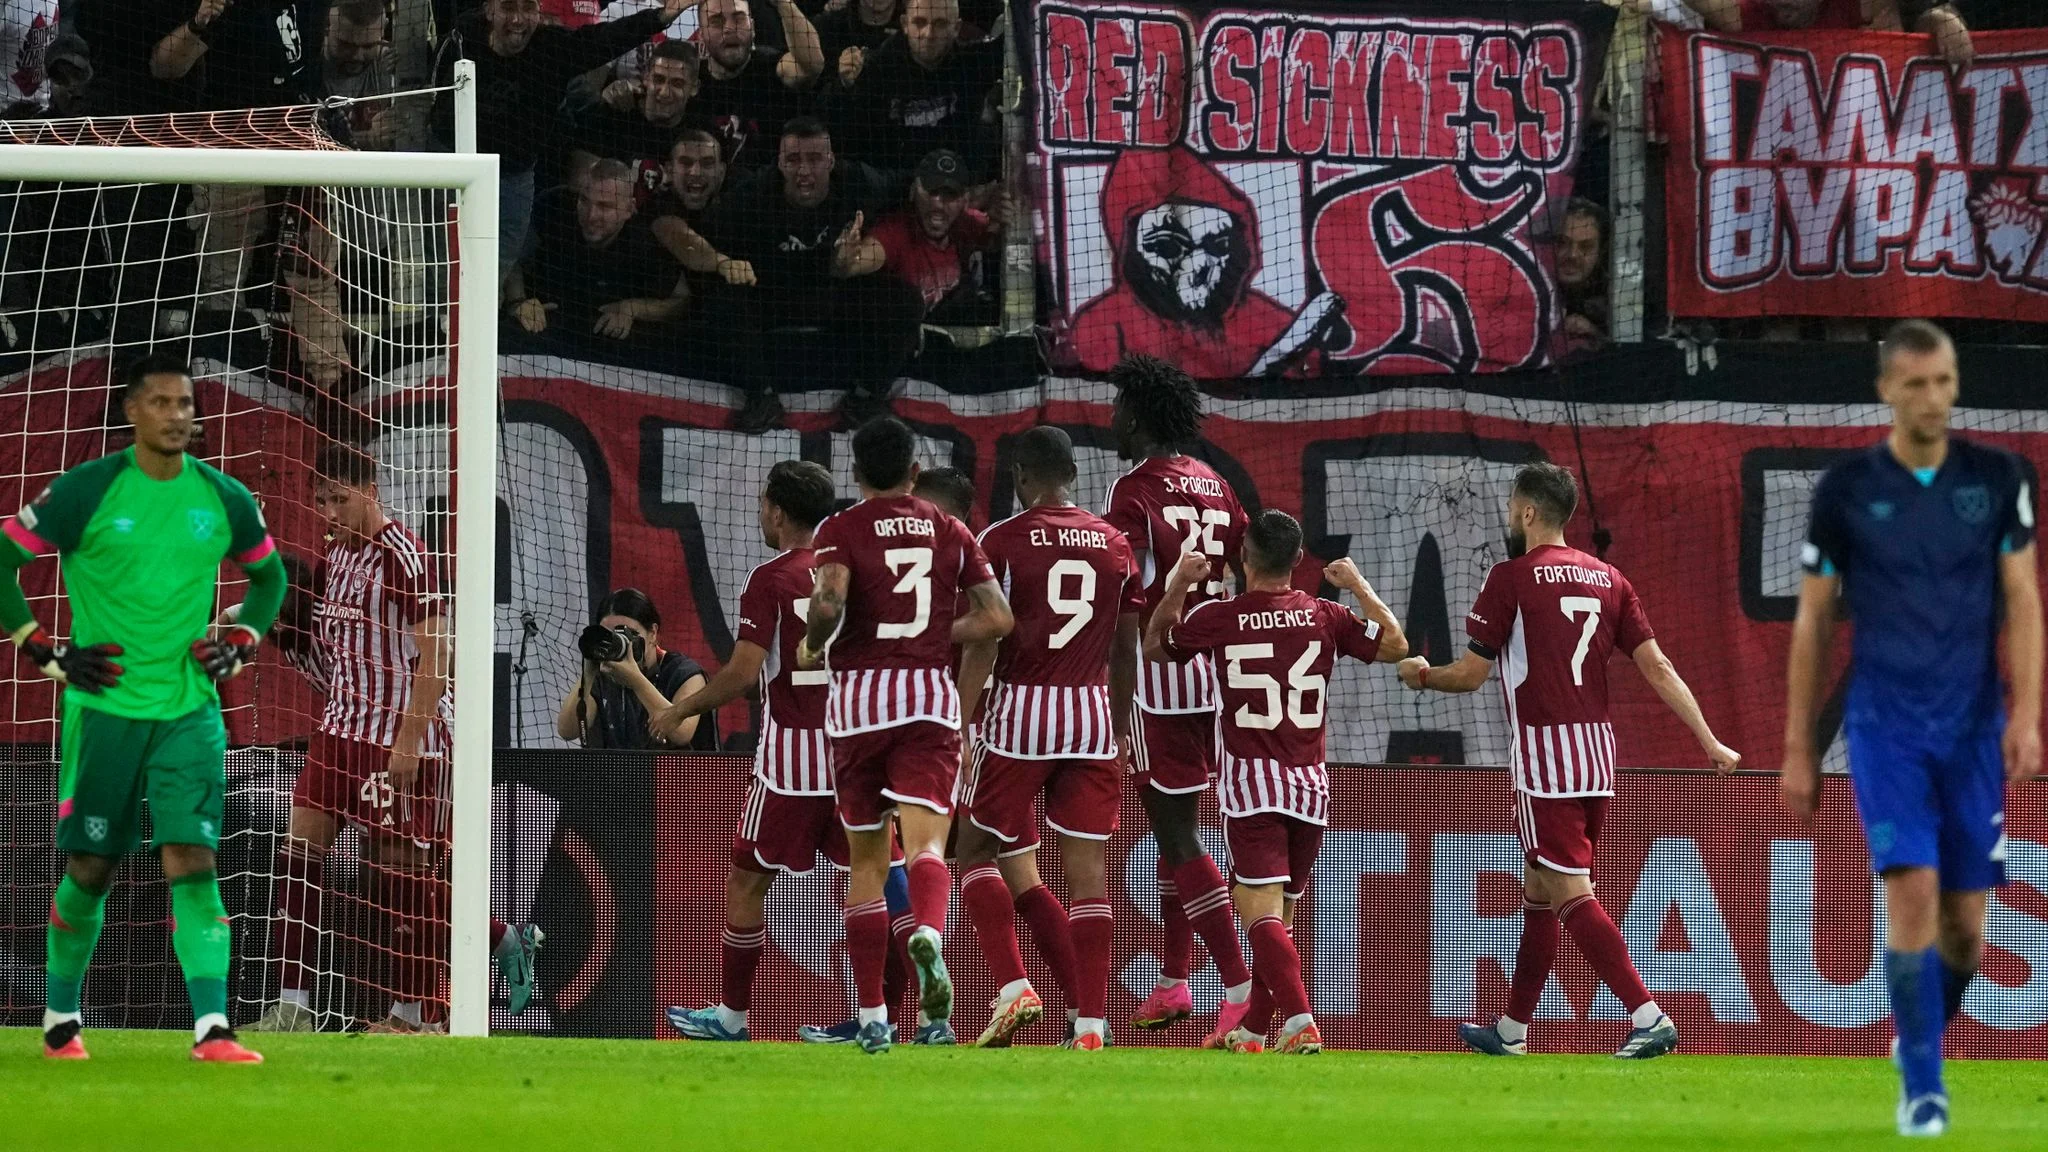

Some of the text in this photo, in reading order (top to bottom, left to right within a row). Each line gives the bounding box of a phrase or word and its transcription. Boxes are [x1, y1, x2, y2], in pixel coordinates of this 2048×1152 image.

[1044, 11, 1571, 162] RED SICKNESS
[1180, 476, 1223, 497] POROZO
[874, 517, 935, 537] ORTEGA
[1030, 529, 1108, 549] EL KAABI
[1162, 506, 1231, 595] 25
[877, 547, 933, 639] 3
[1047, 559, 1097, 649] 9
[1533, 565, 1612, 588] FORTOUNIS
[1238, 609, 1316, 631] PODENCE
[1560, 596, 1601, 686] 7
[1225, 640, 1326, 731] 56
[361, 771, 394, 808] 45
